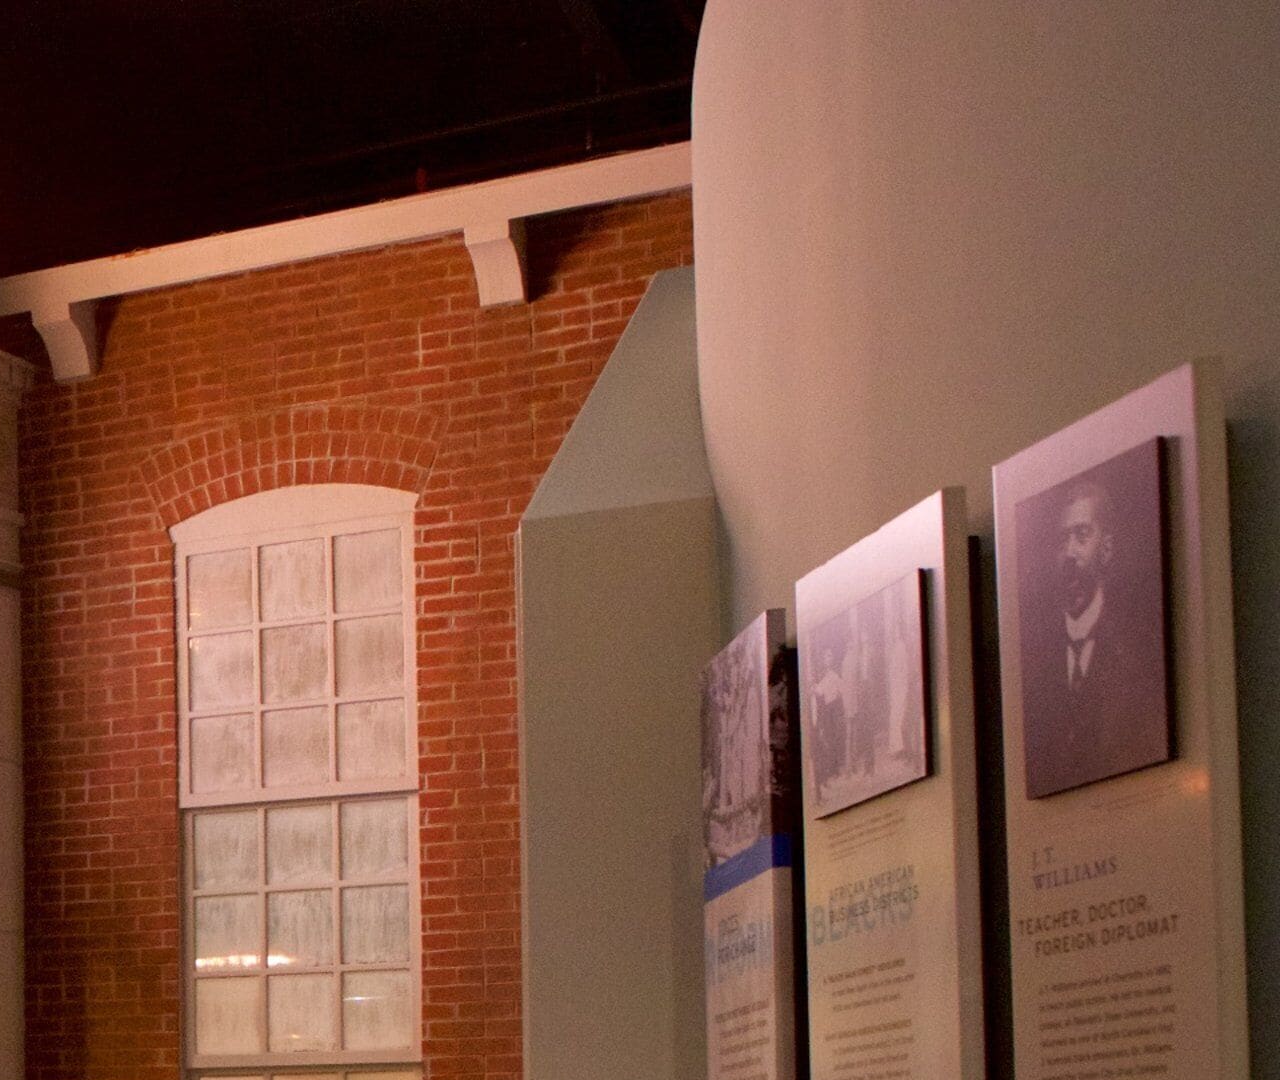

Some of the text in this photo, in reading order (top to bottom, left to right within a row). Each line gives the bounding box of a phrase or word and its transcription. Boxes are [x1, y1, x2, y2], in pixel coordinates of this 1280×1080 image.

[1033, 855, 1118, 890] WILLIAMS
[1035, 913, 1179, 957] FOREIGN DIPLOMAT
